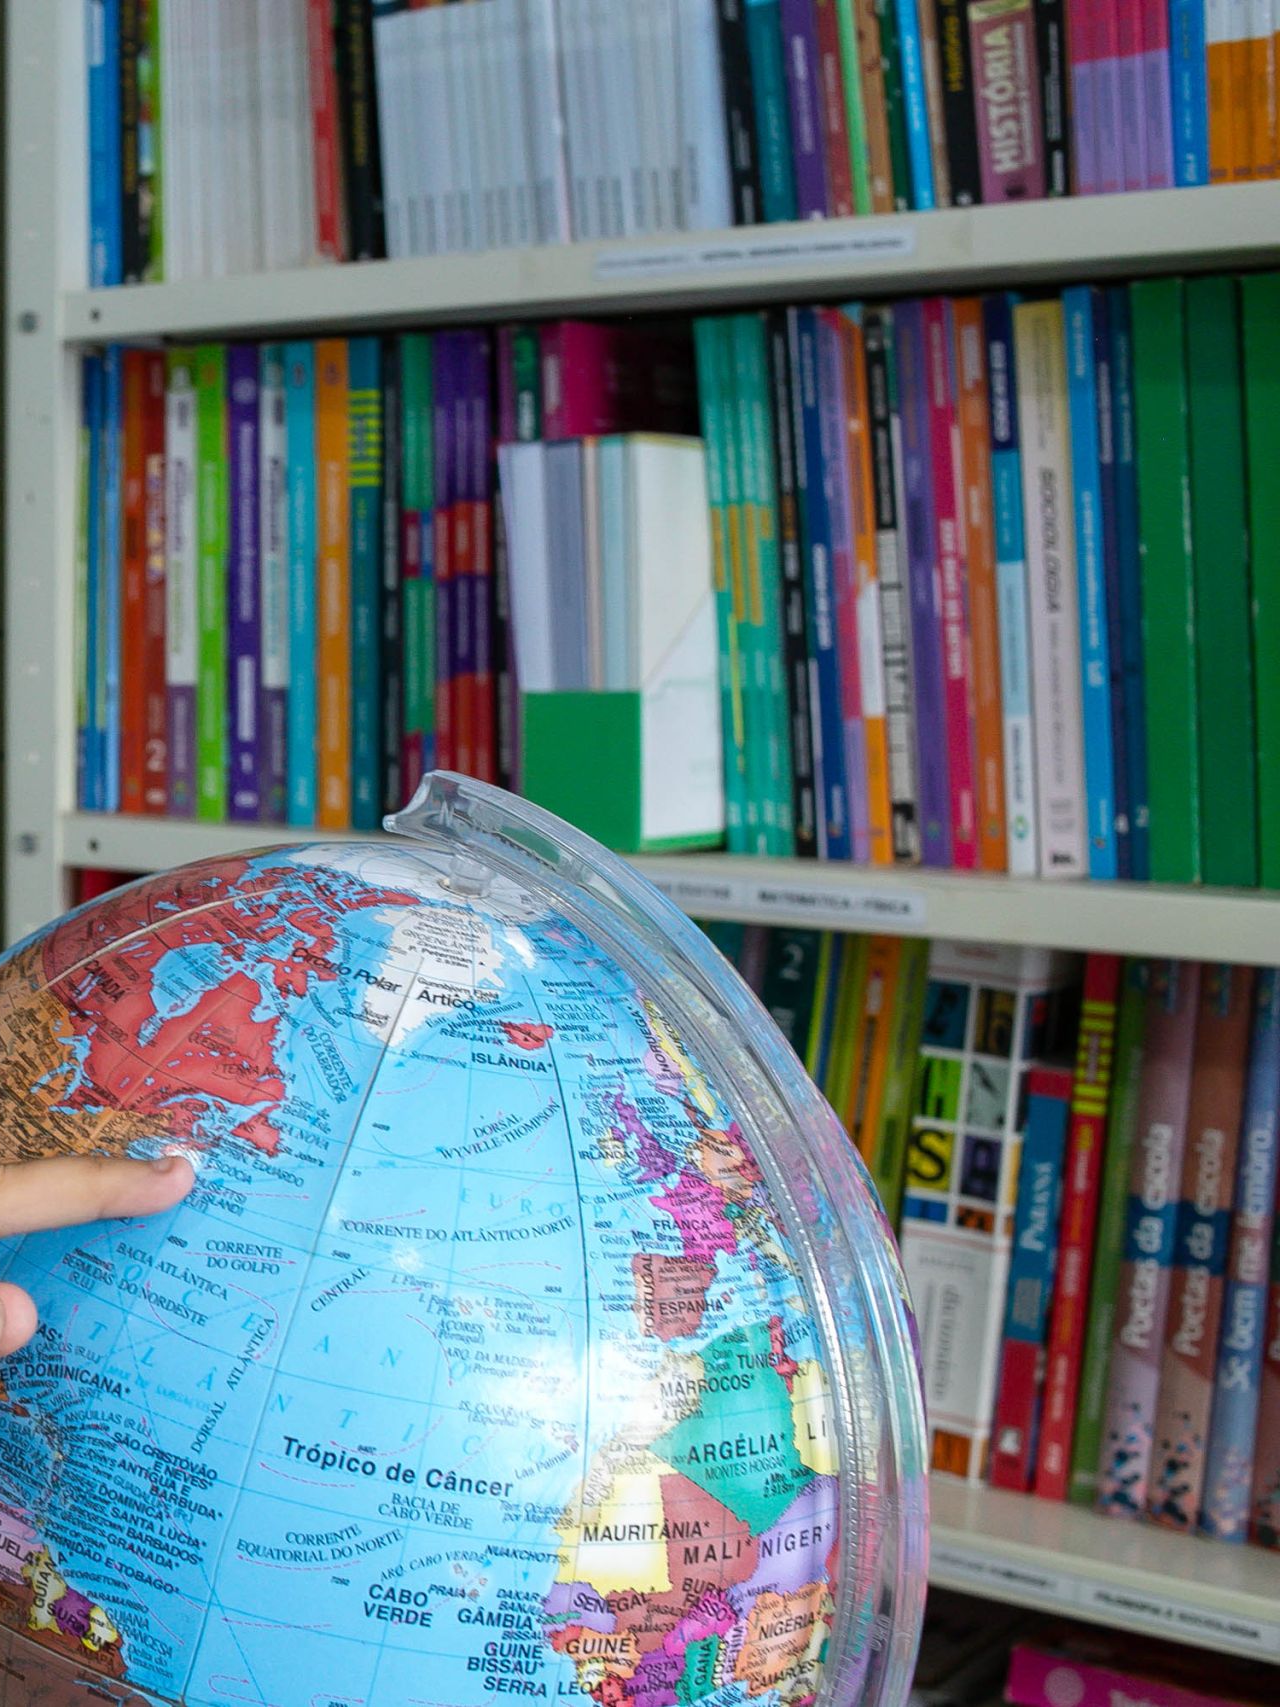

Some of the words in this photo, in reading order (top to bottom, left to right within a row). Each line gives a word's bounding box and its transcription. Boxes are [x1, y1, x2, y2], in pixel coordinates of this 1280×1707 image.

[981, 24, 1021, 174] HISTÓRIA
[84, 959, 127, 1004] CANADÁ
[352, 968, 404, 994] Polar
[416, 985, 476, 1012] Ártico
[302, 1025, 316, 1042] DO
[631, 1009, 673, 1073] NORUEGA
[318, 1031, 354, 1090] CORRENTE
[470, 1051, 550, 1074] ISLÂNDIA
[635, 1096, 666, 1106] REINO
[472, 1112, 525, 1139] DORSAL
[1140, 1121, 1175, 1211] escola
[1193, 1127, 1227, 1217] escola
[340, 1219, 422, 1240] CORRENTE
[425, 1228, 448, 1242] DO
[450, 1226, 531, 1243] ATLÂNTICO
[531, 1213, 577, 1239] NORTE
[652, 1218, 709, 1233] FRANÇA
[1132, 1215, 1165, 1254] da
[1184, 1222, 1215, 1261] da
[205, 1238, 283, 1260] CORRENTE
[1234, 1233, 1265, 1284] me
[115, 1240, 155, 1269] BACIA
[154, 1259, 229, 1302] ATLÂNTICA
[206, 1256, 229, 1270] DO
[230, 1258, 281, 1276] GOLFO
[117, 1277, 140, 1296] DO
[136, 1288, 210, 1328] NORDESTE
[641, 1252, 656, 1339] PORTUGAL
[658, 1298, 725, 1315] ESPANHA
[1118, 1257, 1161, 1349] Poetas
[1171, 1265, 1210, 1358] Poetas
[1224, 1288, 1257, 1351] bem
[190, 1399, 228, 1456] DORSAL
[226, 1316, 276, 1392] ATLÂNTICA
[309, 1266, 371, 1314] CENTRAL
[1218, 1355, 1253, 1393] Se
[23, 1363, 124, 1399] DOMINICANA
[659, 1374, 750, 1398] MARROCOS
[112, 1430, 141, 1452] SÃO
[141, 1441, 219, 1482] CRISTÓVÃO
[687, 1432, 778, 1465] ARGÉLIA
[117, 1458, 178, 1495] ANTÍGUA
[181, 1482, 193, 1498] E
[153, 1459, 163, 1474] E
[163, 1462, 211, 1492] NEVES
[281, 1433, 377, 1477] Trópico
[384, 1461, 417, 1485] de
[425, 1466, 515, 1499] Câncer
[98, 1483, 165, 1522] DOMINICA
[148, 1482, 218, 1522] BARBUDA
[377, 1502, 422, 1523] CABO
[425, 1511, 475, 1532] VERDE
[391, 1491, 437, 1514] BACIA
[439, 1500, 462, 1516] DE
[109, 1505, 156, 1535] SANTA
[284, 1522, 363, 1547] CORRENTE
[582, 1518, 703, 1543] MAURITÂNIA
[125, 1527, 200, 1566] BARBADOS
[235, 1537, 326, 1563] EQUATORIAL
[330, 1546, 355, 1561] DO
[355, 1528, 405, 1557] NORTE
[683, 1539, 742, 1566] MALI
[761, 1524, 823, 1559] NÍGER
[408, 1553, 444, 1573] CABO
[446, 1549, 488, 1564] VERDE
[116, 1562, 176, 1595] TOBAGO
[367, 1583, 429, 1608] CABO
[426, 1582, 467, 1601] PRAIA
[495, 1588, 542, 1603] DAKAR
[572, 1591, 653, 1614] SENEGAL
[104, 1607, 150, 1631] GUIANA
[362, 1600, 434, 1629] VERDE
[456, 1605, 535, 1630] GÂMBIA
[466, 1656, 539, 1676] BISSAU
[634, 1660, 680, 1674] COSTA
[482, 1675, 548, 1698] SERRA
